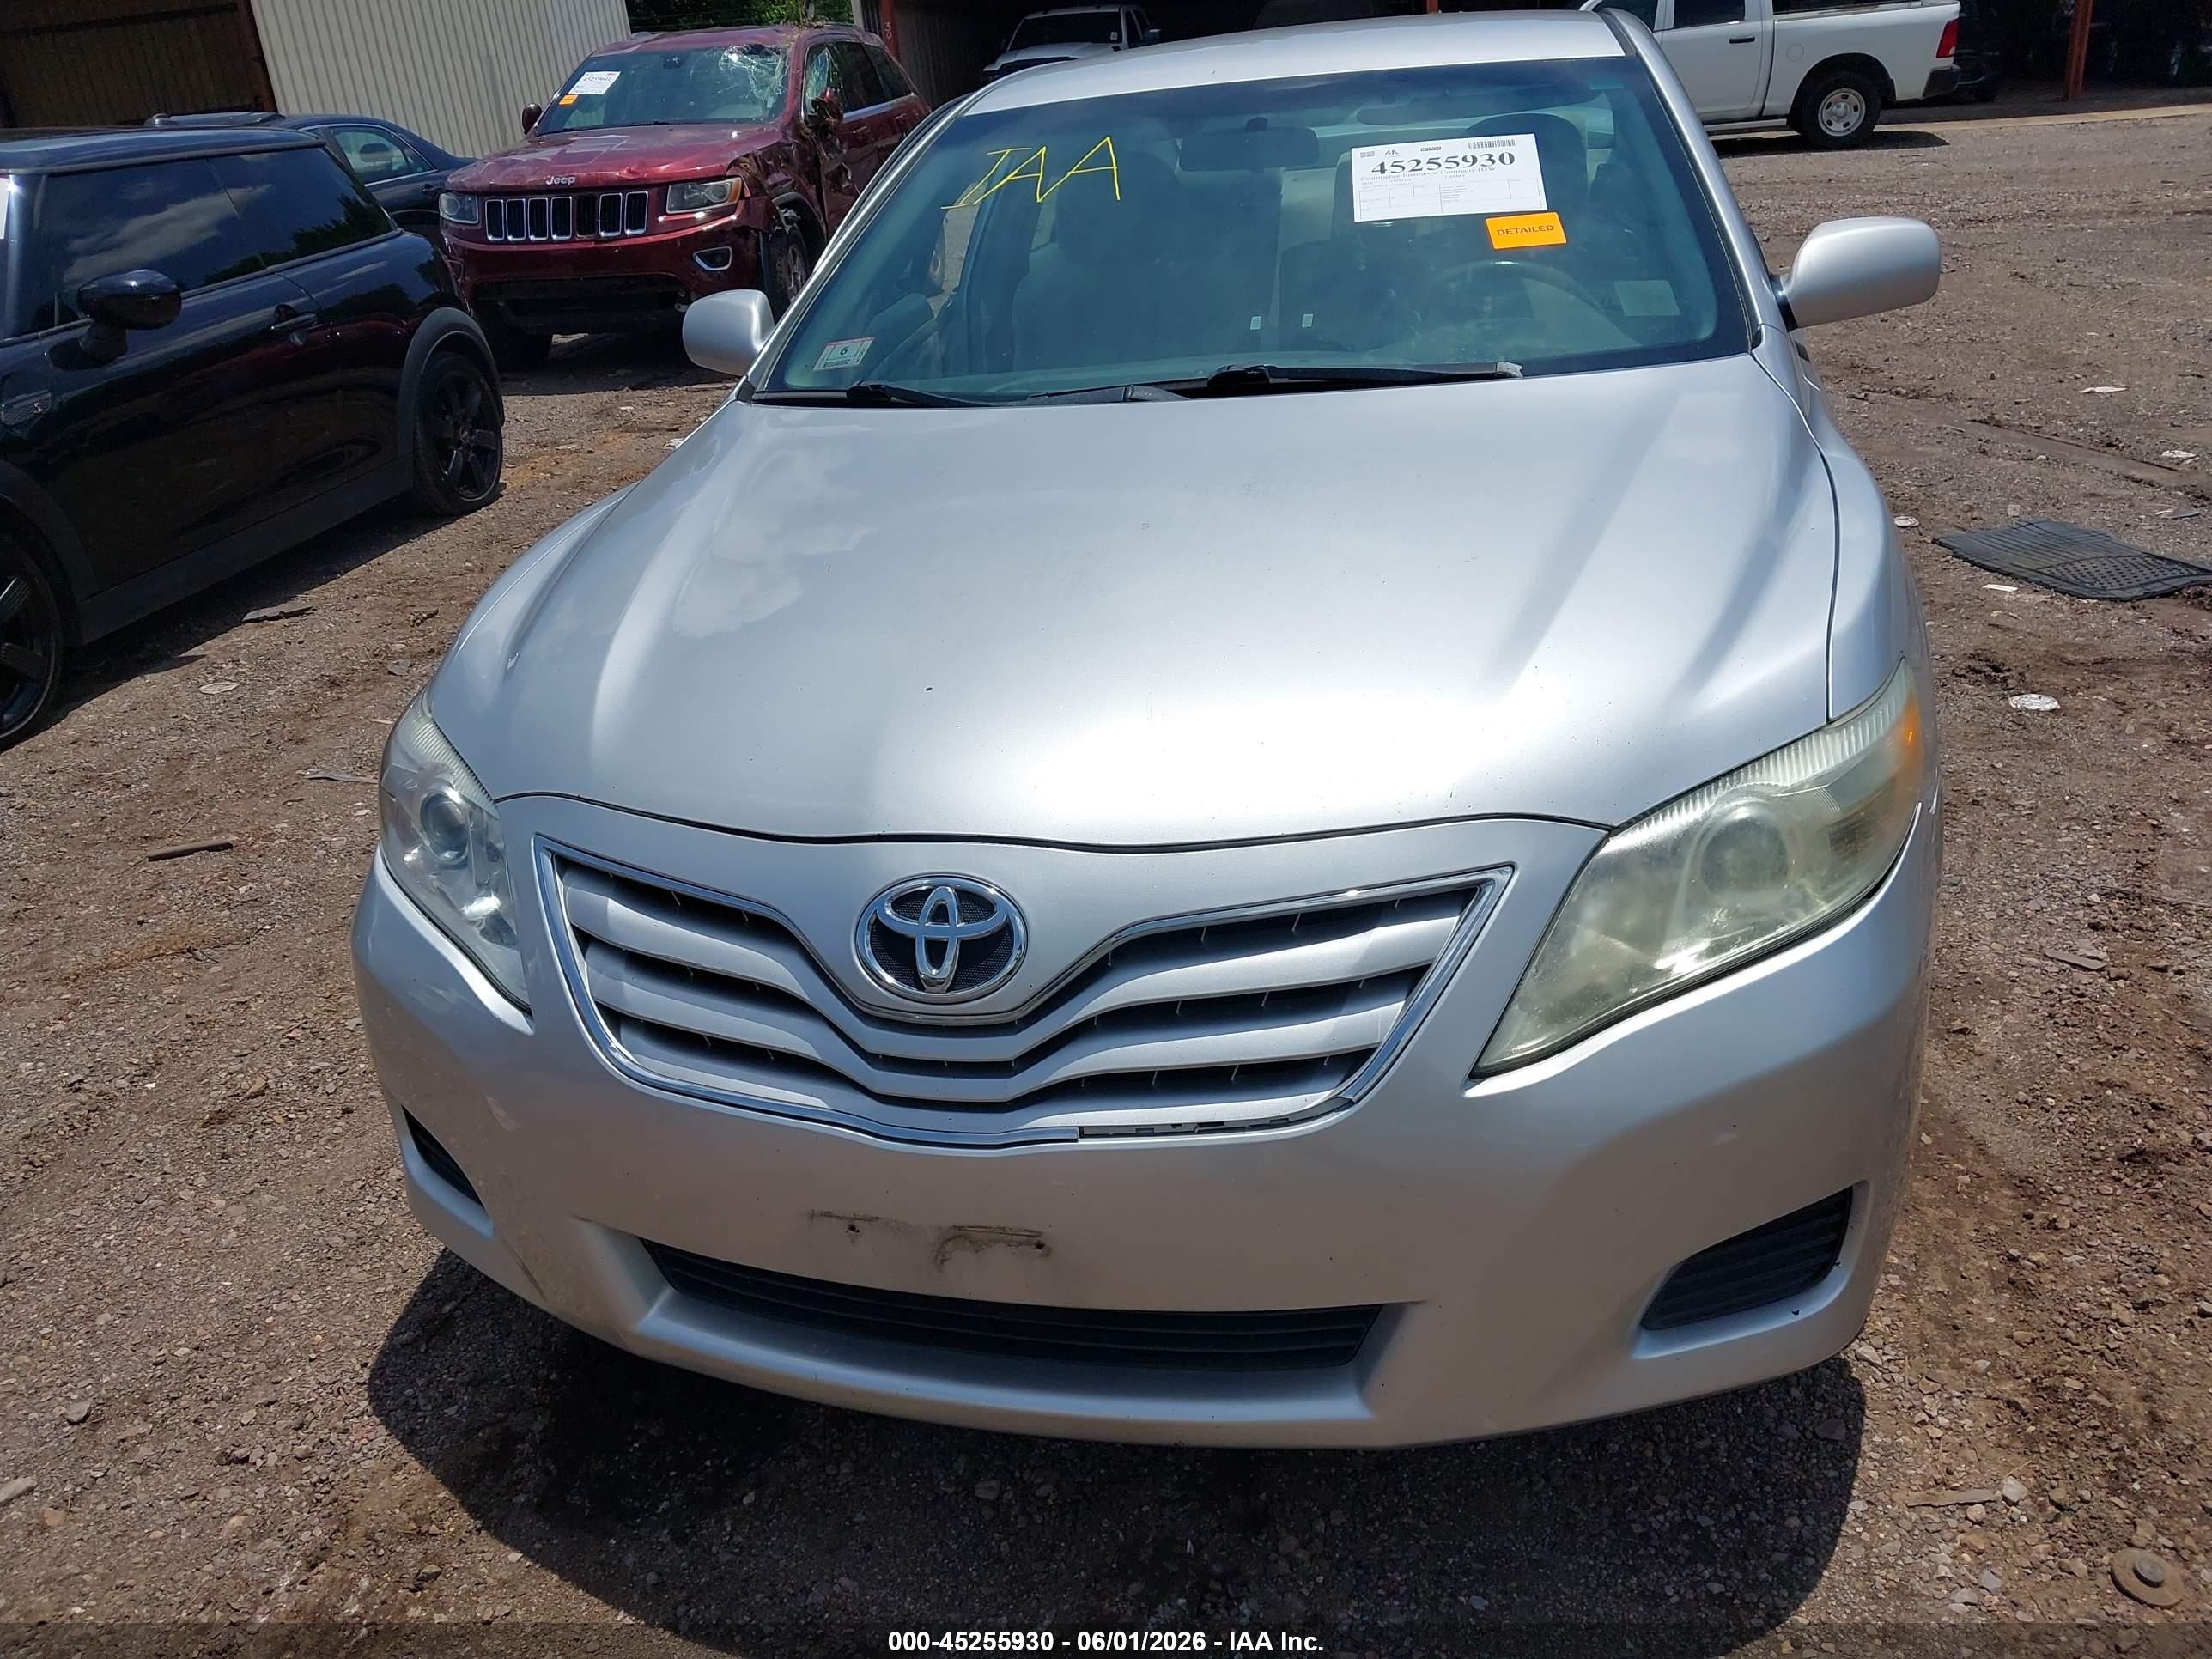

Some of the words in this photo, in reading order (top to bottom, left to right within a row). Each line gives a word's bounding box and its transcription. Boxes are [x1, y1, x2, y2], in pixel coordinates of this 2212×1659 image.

[1371, 152, 1515, 174] 45255930
[941, 136, 1121, 209] IAA
[545, 175, 576, 186] Jeep
[1497, 224, 1554, 237] DETAILED
[840, 345, 849, 356] 6
